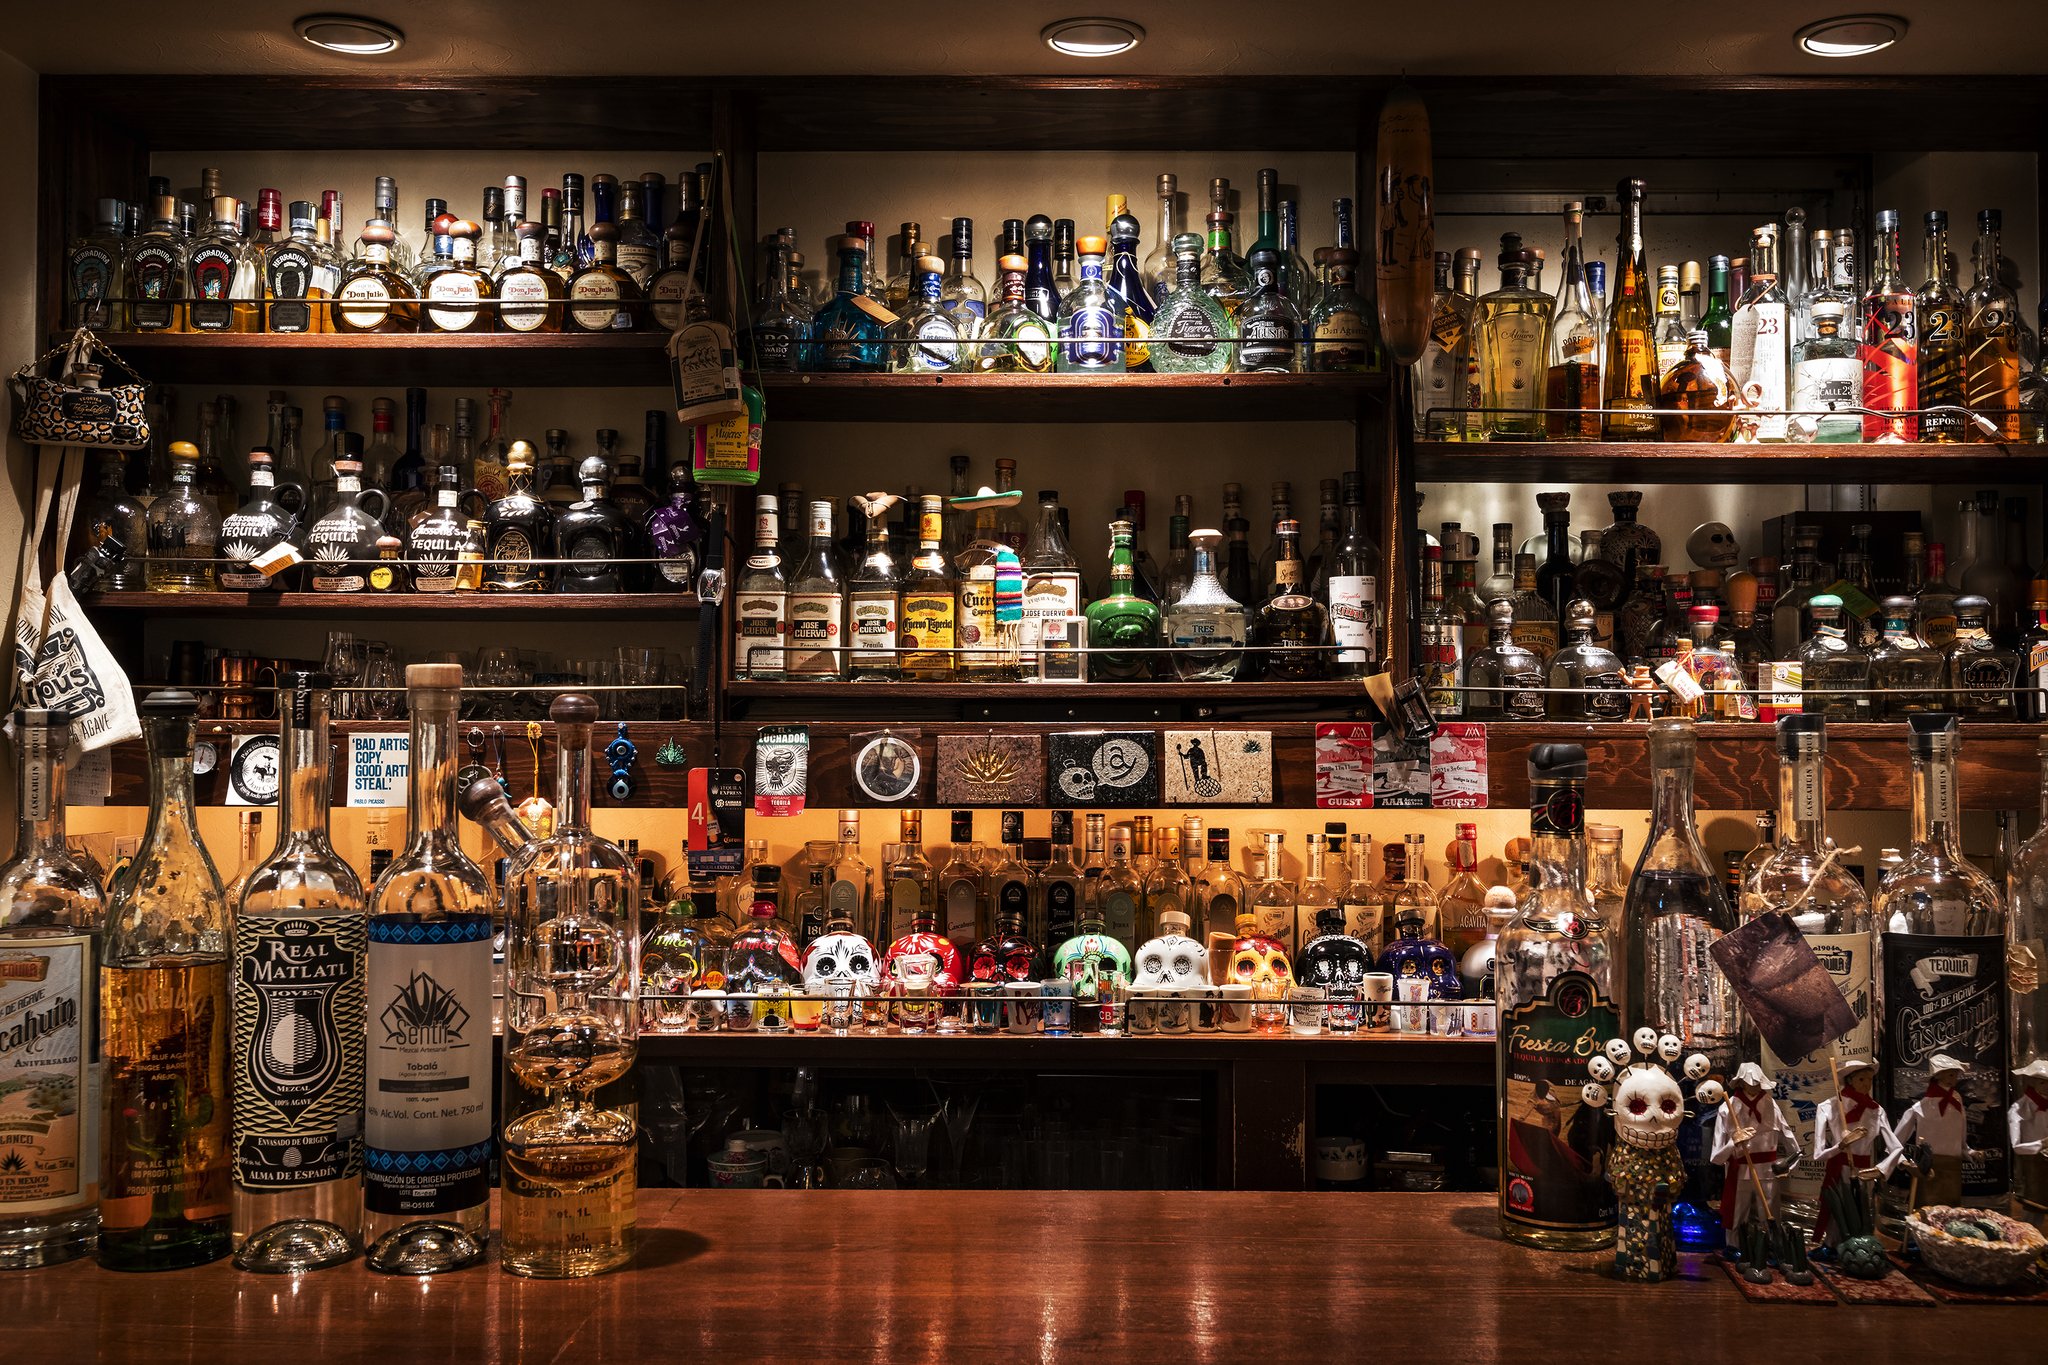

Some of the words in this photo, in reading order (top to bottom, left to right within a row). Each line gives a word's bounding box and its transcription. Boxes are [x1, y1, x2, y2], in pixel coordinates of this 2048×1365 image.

[73, 249, 111, 265] HERRADURA
[135, 248, 173, 264] HERRADURA
[194, 249, 233, 265] HERRADURA
[272, 252, 309, 268] HERRADURA
[346, 290, 365, 300] Don
[366, 289, 384, 300] Julio
[435, 285, 454, 294] Don
[454, 286, 473, 296] Julio
[508, 286, 526, 294] Don
[526, 286, 543, 296] Julio
[578, 285, 596, 294] Don
[596, 286, 614, 296] Julio
[1174, 320, 1212, 334] Tierra
[1322, 325, 1339, 334] Don
[1757, 317, 1779, 335] 23
[1884, 311, 1916, 340] 23
[1928, 310, 1963, 342] 23
[1985, 310, 2018, 340] 23
[1819, 388, 1842, 397] CALLE
[711, 427, 743, 442] Mujeres
[221, 527, 268, 538] TEQUILA
[309, 532, 359, 544] TEQUILA
[412, 539, 465, 551] TEQUILA
[962, 591, 995, 608] Cuer
[750, 618, 769, 627] JOSE
[800, 621, 819, 629] JOSE
[864, 618, 880, 626] JOSE
[902, 617, 926, 633] Cuervo
[926, 617, 953, 634] Especial
[743, 627, 775, 636] CUERVO
[794, 629, 827, 638] CUERVO
[859, 625, 886, 634] CUERVO
[1191, 624, 1215, 634] TRES
[1281, 639, 1304, 648] TRES
[1512, 634, 1554, 646] ENTENARIO
[83, 713, 112, 740] AGAVE
[379, 737, 409, 751] ARTIS
[758, 732, 806, 745] LUCHADOR
[1805, 733, 1813, 762] TEQUIL
[355, 752, 384, 764] COPY.
[355, 764, 382, 777] GOOD
[384, 764, 409, 777] ARTI
[31, 766, 40, 817] CASCAHUIN
[1805, 768, 1813, 817] CASCAHUIN
[1940, 768, 1948, 818] CASCAHUIN
[1327, 798, 1363, 807] GUEST
[1443, 798, 1477, 807] GUEST
[691, 802, 705, 826] 4
[244, 955, 348, 983] MATLATL
[1928, 957, 1969, 974] TEQUILA
[269, 988, 324, 998] JOVEN
[5, 1003, 16, 1016] DE
[17, 989, 46, 1011] AGAVE
[1922, 1001, 1941, 1016] 100%
[1941, 995, 1953, 1009] DE
[1953, 983, 1977, 1004] AGAVE
[396, 1017, 450, 1046] Sentir
[1508, 1023, 1572, 1058] Fiesta
[1572, 1025, 1611, 1061] Bra
[398, 1045, 419, 1054] Mezcal
[420, 1044, 447, 1054] Artesanal
[1839, 1044, 1870, 1057] TAHONA
[14, 1055, 79, 1069] ANIVERSARIO
[1513, 1052, 1545, 1064] TEQUILA
[407, 1061, 438, 1071] Tobalá
[1513, 1072, 1531, 1082] 100%
[1564, 1078, 1576, 1087] DE
[276, 1084, 311, 1094] MEZCAL
[273, 1098, 290, 1108] 100%
[290, 1097, 313, 1107] AGAVE
[419, 1096, 439, 1104] Agave
[413, 1109, 438, 1119] Cont.
[440, 1108, 459, 1118] Net.
[460, 1105, 474, 1115] 750
[475, 1103, 484, 1112] ml
[0, 1134, 34, 1145] LANCO
[257, 1137, 291, 1147] ENVASADO
[291, 1137, 302, 1146] DE
[302, 1135, 329, 1145] ORIGEN
[249, 1170, 275, 1181] ALMA
[275, 1170, 292, 1180] DE
[294, 1165, 338, 1180] ESPADÍN
[405, 1175, 416, 1185] DE
[417, 1173, 446, 1185] ORIGEN
[446, 1167, 481, 1182] PROTEGIDA
[16, 1175, 49, 1185] MEXICO
[127, 1184, 160, 1196] PRODUCT
[161, 1184, 171, 1194] OF
[576, 1207, 591, 1218] 1L
